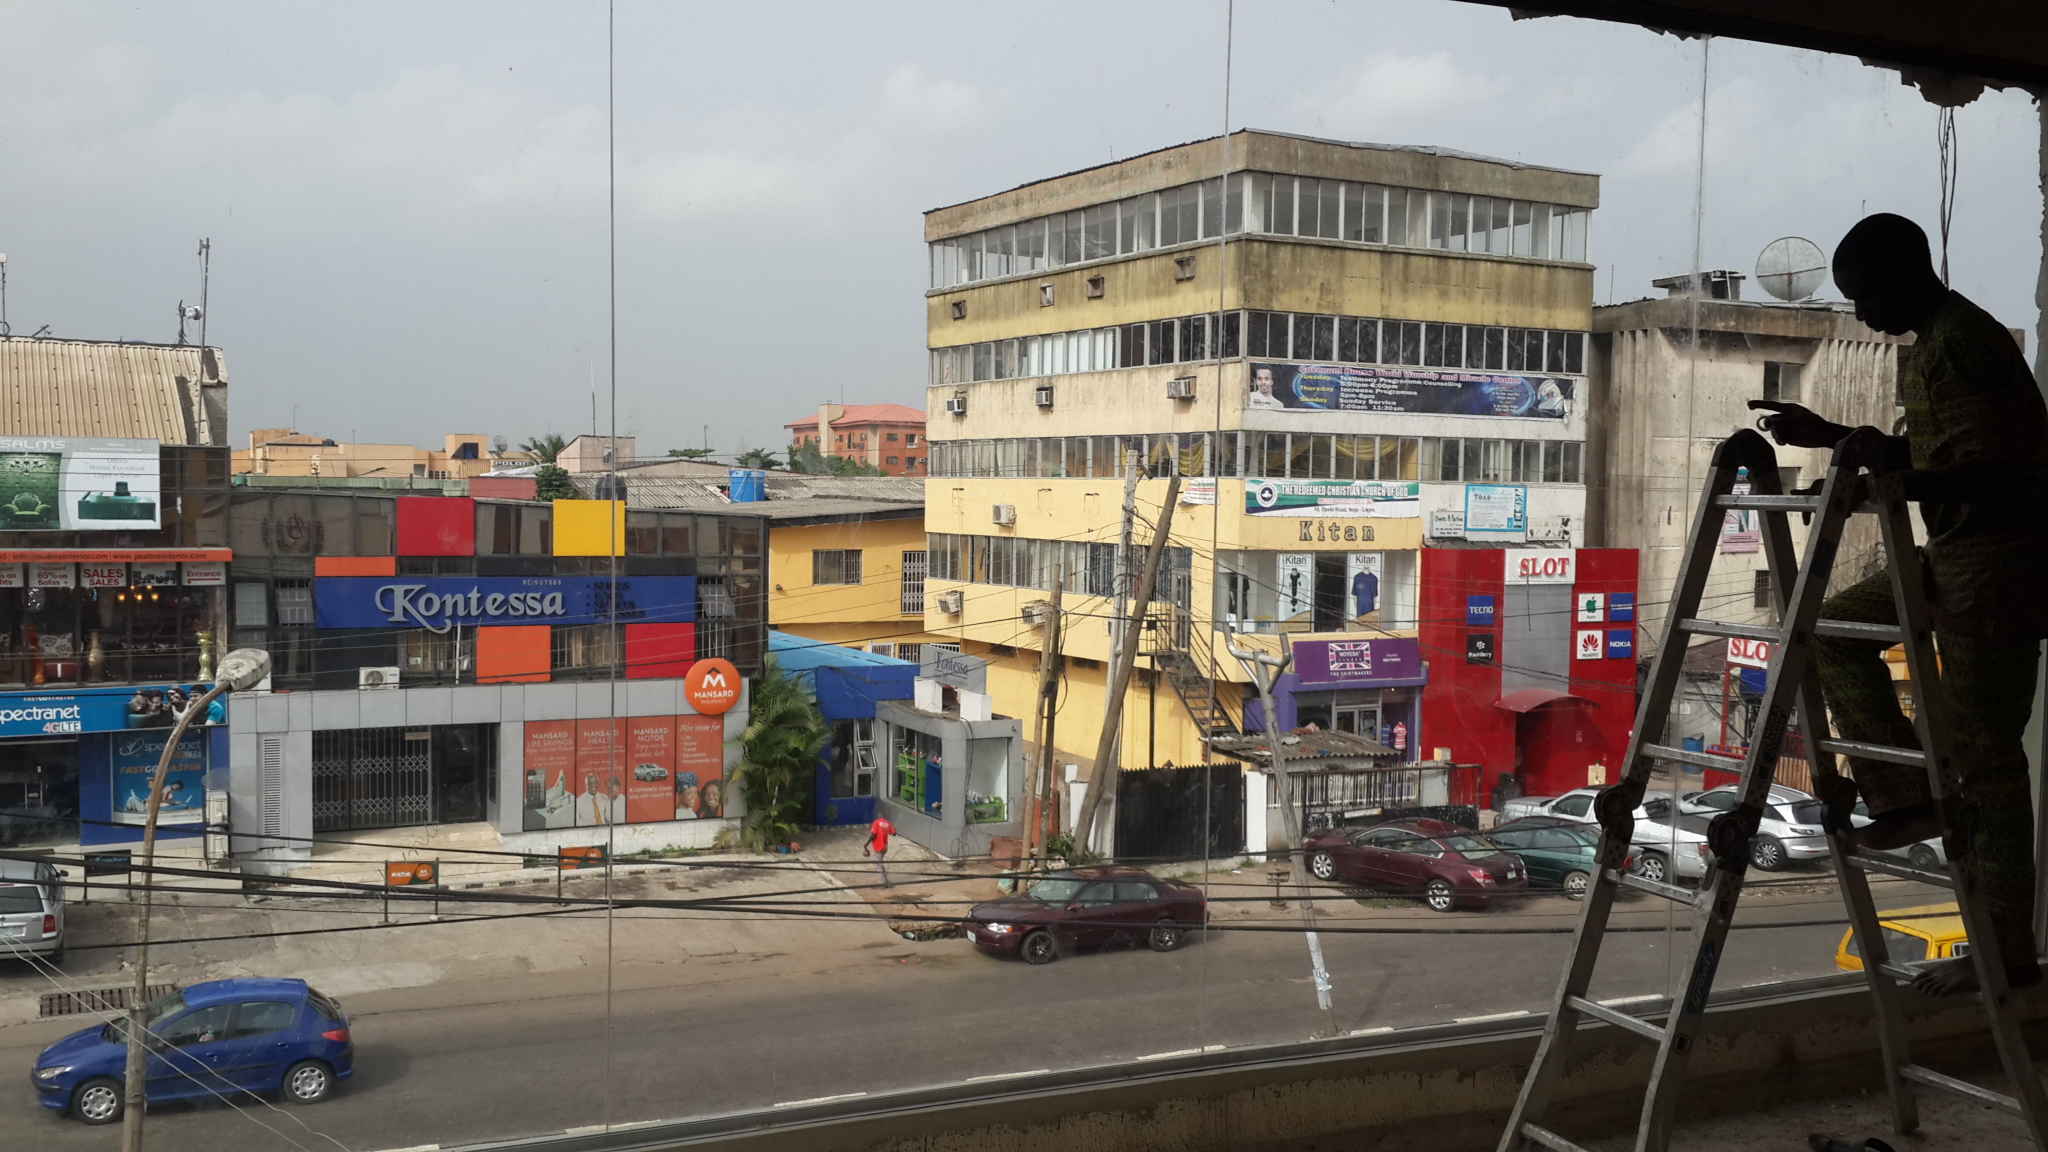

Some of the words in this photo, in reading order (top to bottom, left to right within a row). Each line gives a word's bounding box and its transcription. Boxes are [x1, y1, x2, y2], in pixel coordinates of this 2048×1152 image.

[1299, 520, 1375, 543] Kitan
[1285, 555, 1307, 565] Kitan
[1355, 555, 1377, 564] Kitan
[1519, 557, 1569, 577] SLOT
[83, 569, 124, 578] SALES
[89, 578, 120, 586] SALES
[375, 584, 567, 633] Kontessa
[1730, 638, 1770, 661] SLO
[694, 689, 733, 698] MANSARD
[0, 704, 81, 724] pectranet
